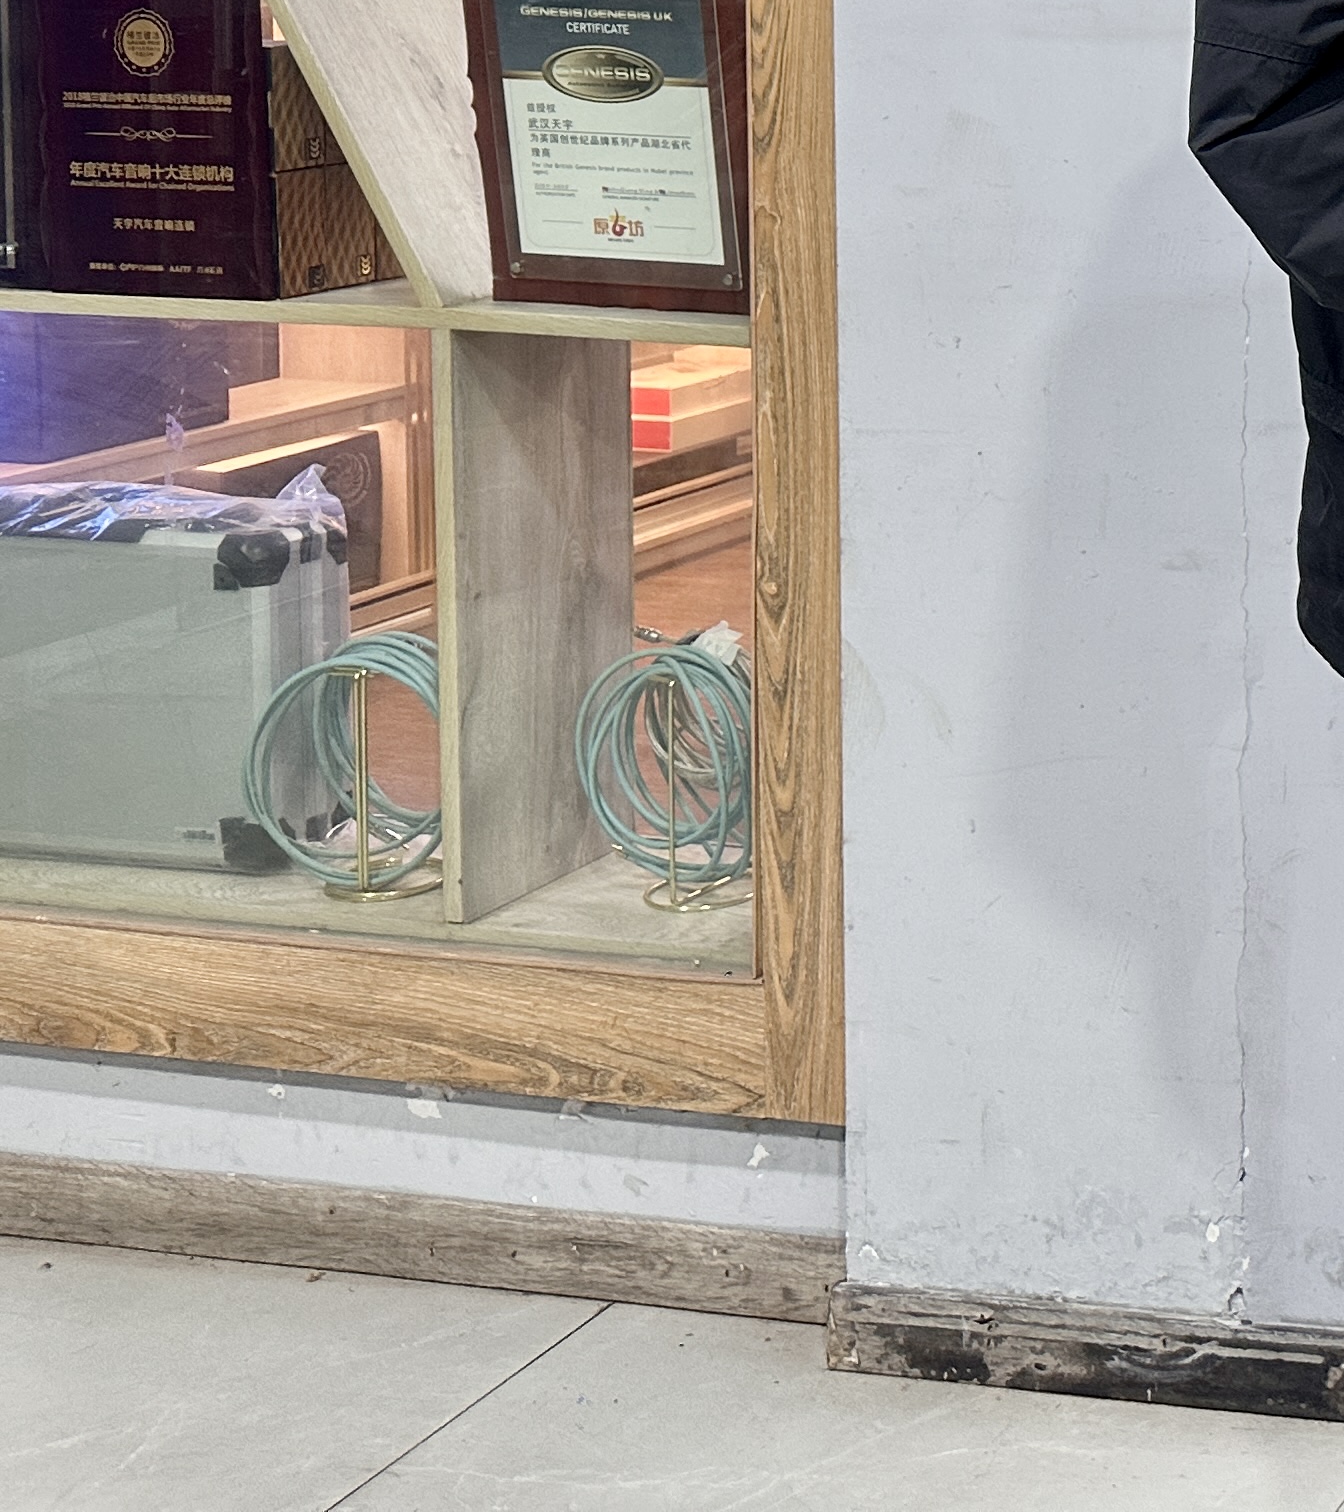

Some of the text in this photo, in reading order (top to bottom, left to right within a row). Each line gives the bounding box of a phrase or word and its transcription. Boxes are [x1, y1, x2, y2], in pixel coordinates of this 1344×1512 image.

[565, 21, 630, 35] CERTIFICATE
[69, 160, 234, 183] 年度汽车音响十大连锁机构
